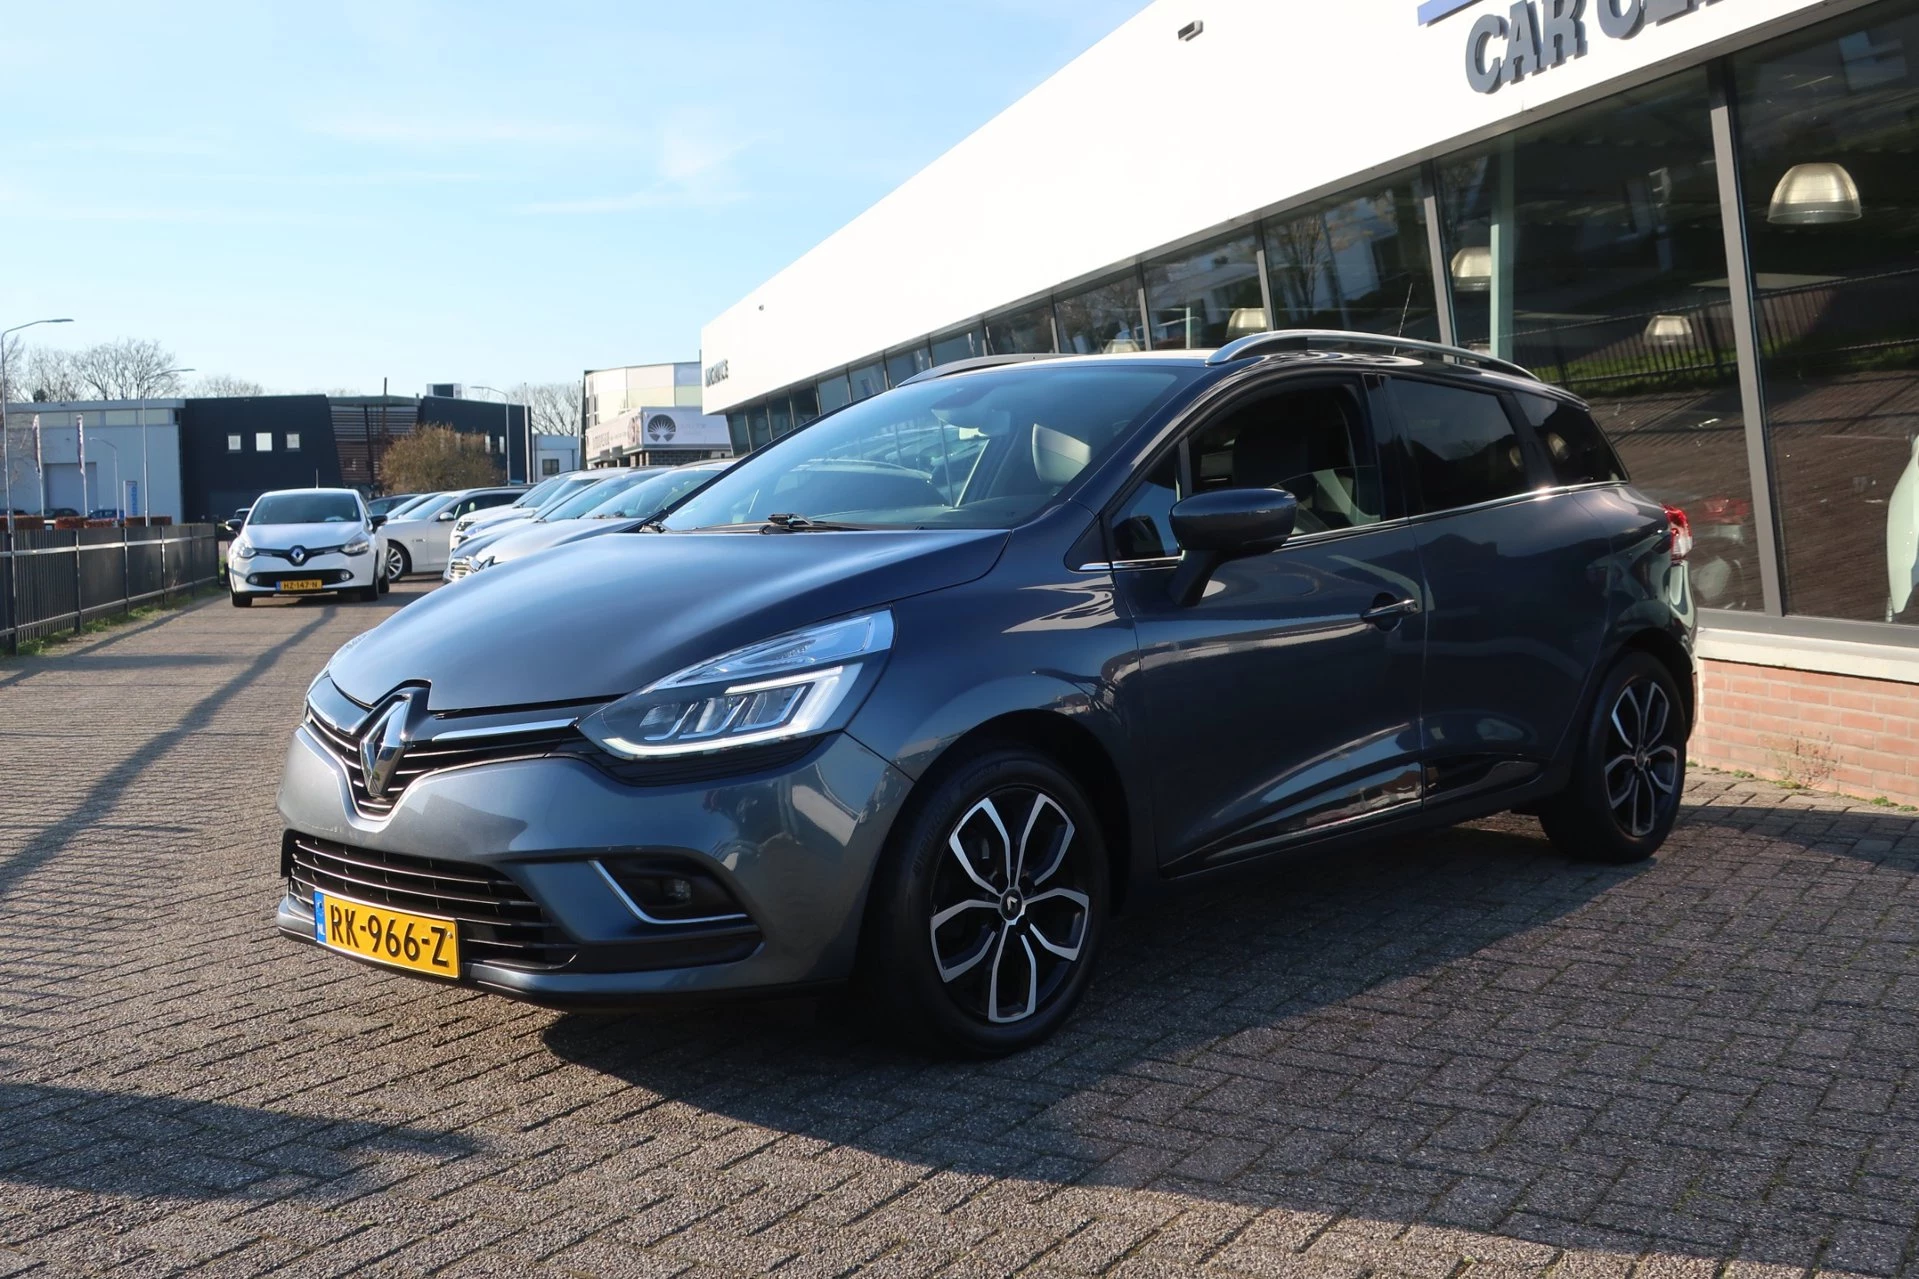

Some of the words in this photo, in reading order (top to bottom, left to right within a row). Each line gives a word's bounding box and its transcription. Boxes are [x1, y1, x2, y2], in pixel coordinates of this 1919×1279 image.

[1465, 0, 1588, 94] CAR
[283, 581, 318, 590] HZ-147-N
[330, 904, 449, 968] RK-966-Z
